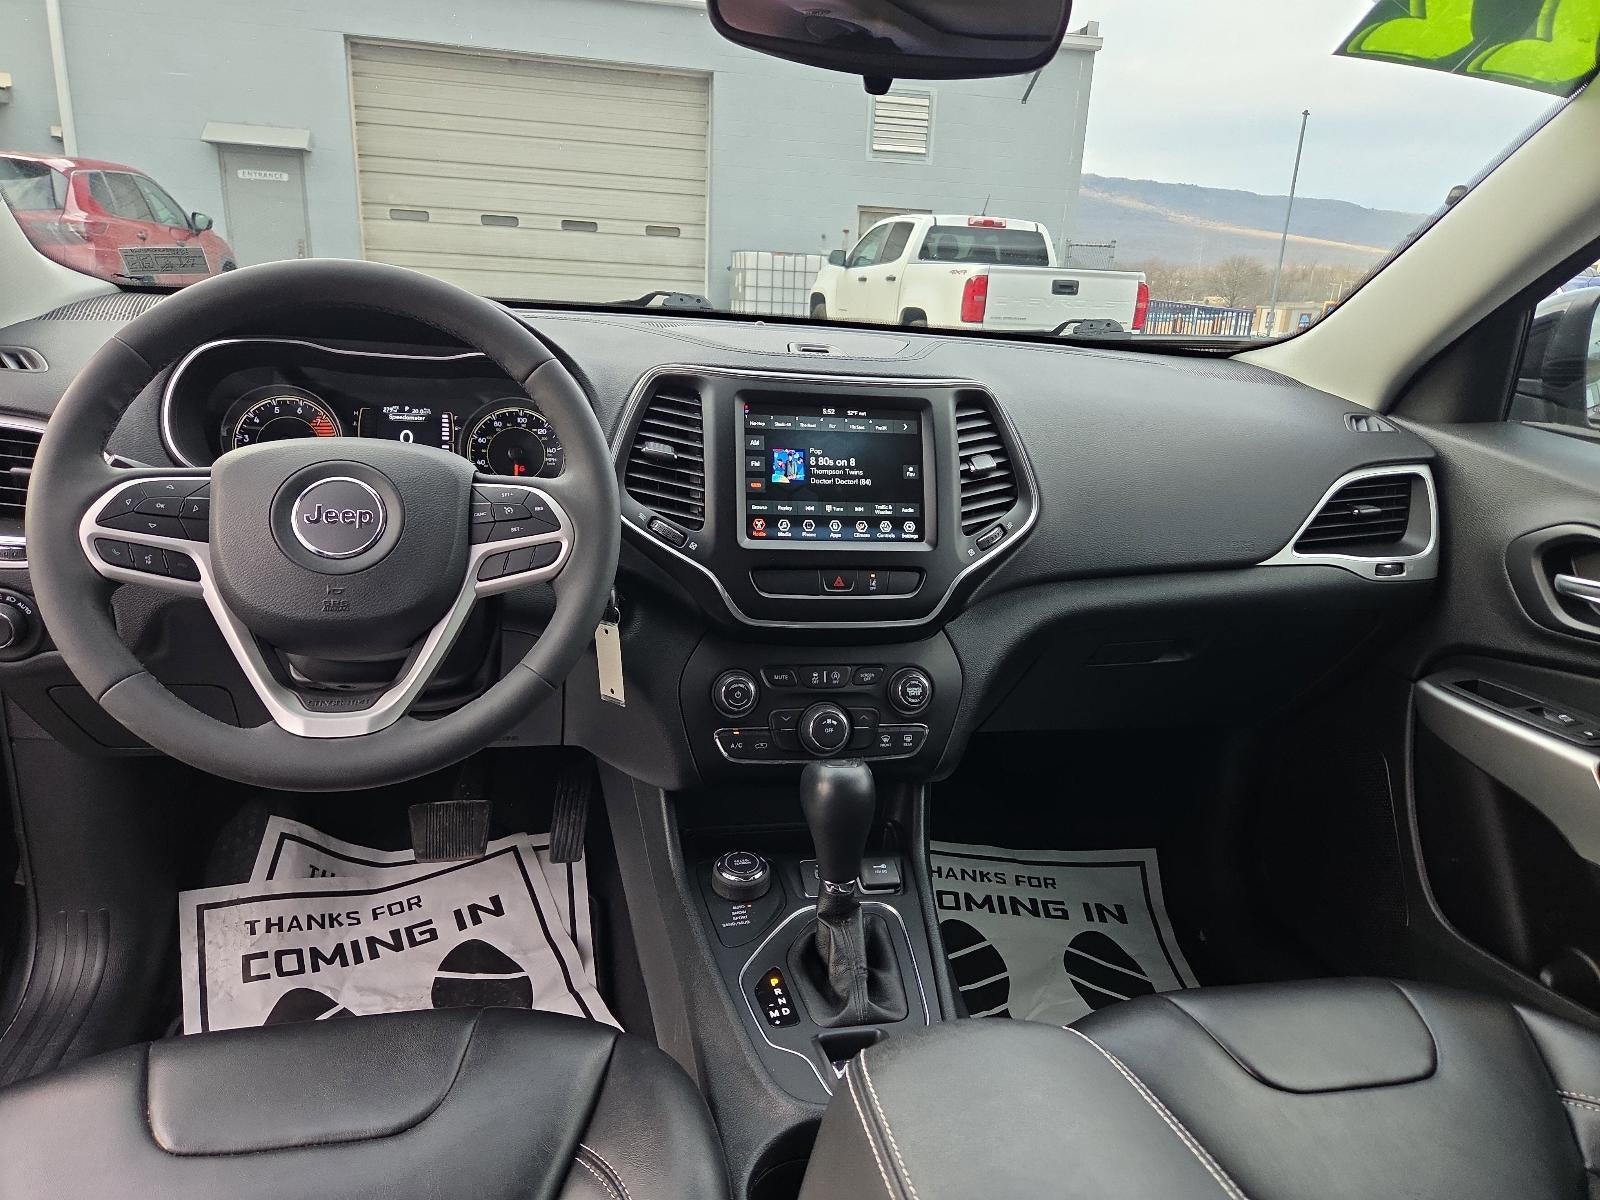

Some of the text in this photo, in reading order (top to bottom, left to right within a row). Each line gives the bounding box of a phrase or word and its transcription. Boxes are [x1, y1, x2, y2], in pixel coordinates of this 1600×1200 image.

[242, 170, 285, 180] ENTRANCE
[315, 418, 321, 426] 7
[243, 434, 250, 443] 3
[809, 447, 822, 455] Pop
[809, 457, 816, 466] 8
[818, 457, 834, 466] 80s
[850, 457, 856, 466] 8
[810, 468, 844, 476] Thompson
[859, 478, 872, 487] (84)
[303, 503, 374, 529] Jeep
[17, 601, 32, 615] AUTO
[931, 865, 1057, 890] HANKS FOR
[935, 889, 1129, 925] OMING IN
[244, 895, 423, 936] THANKS FOR
[241, 893, 505, 984] COMING IN
[770, 978, 779, 987] P
[773, 987, 783, 996] R
[777, 997, 787, 1006] N
[769, 1007, 790, 1019] M D
